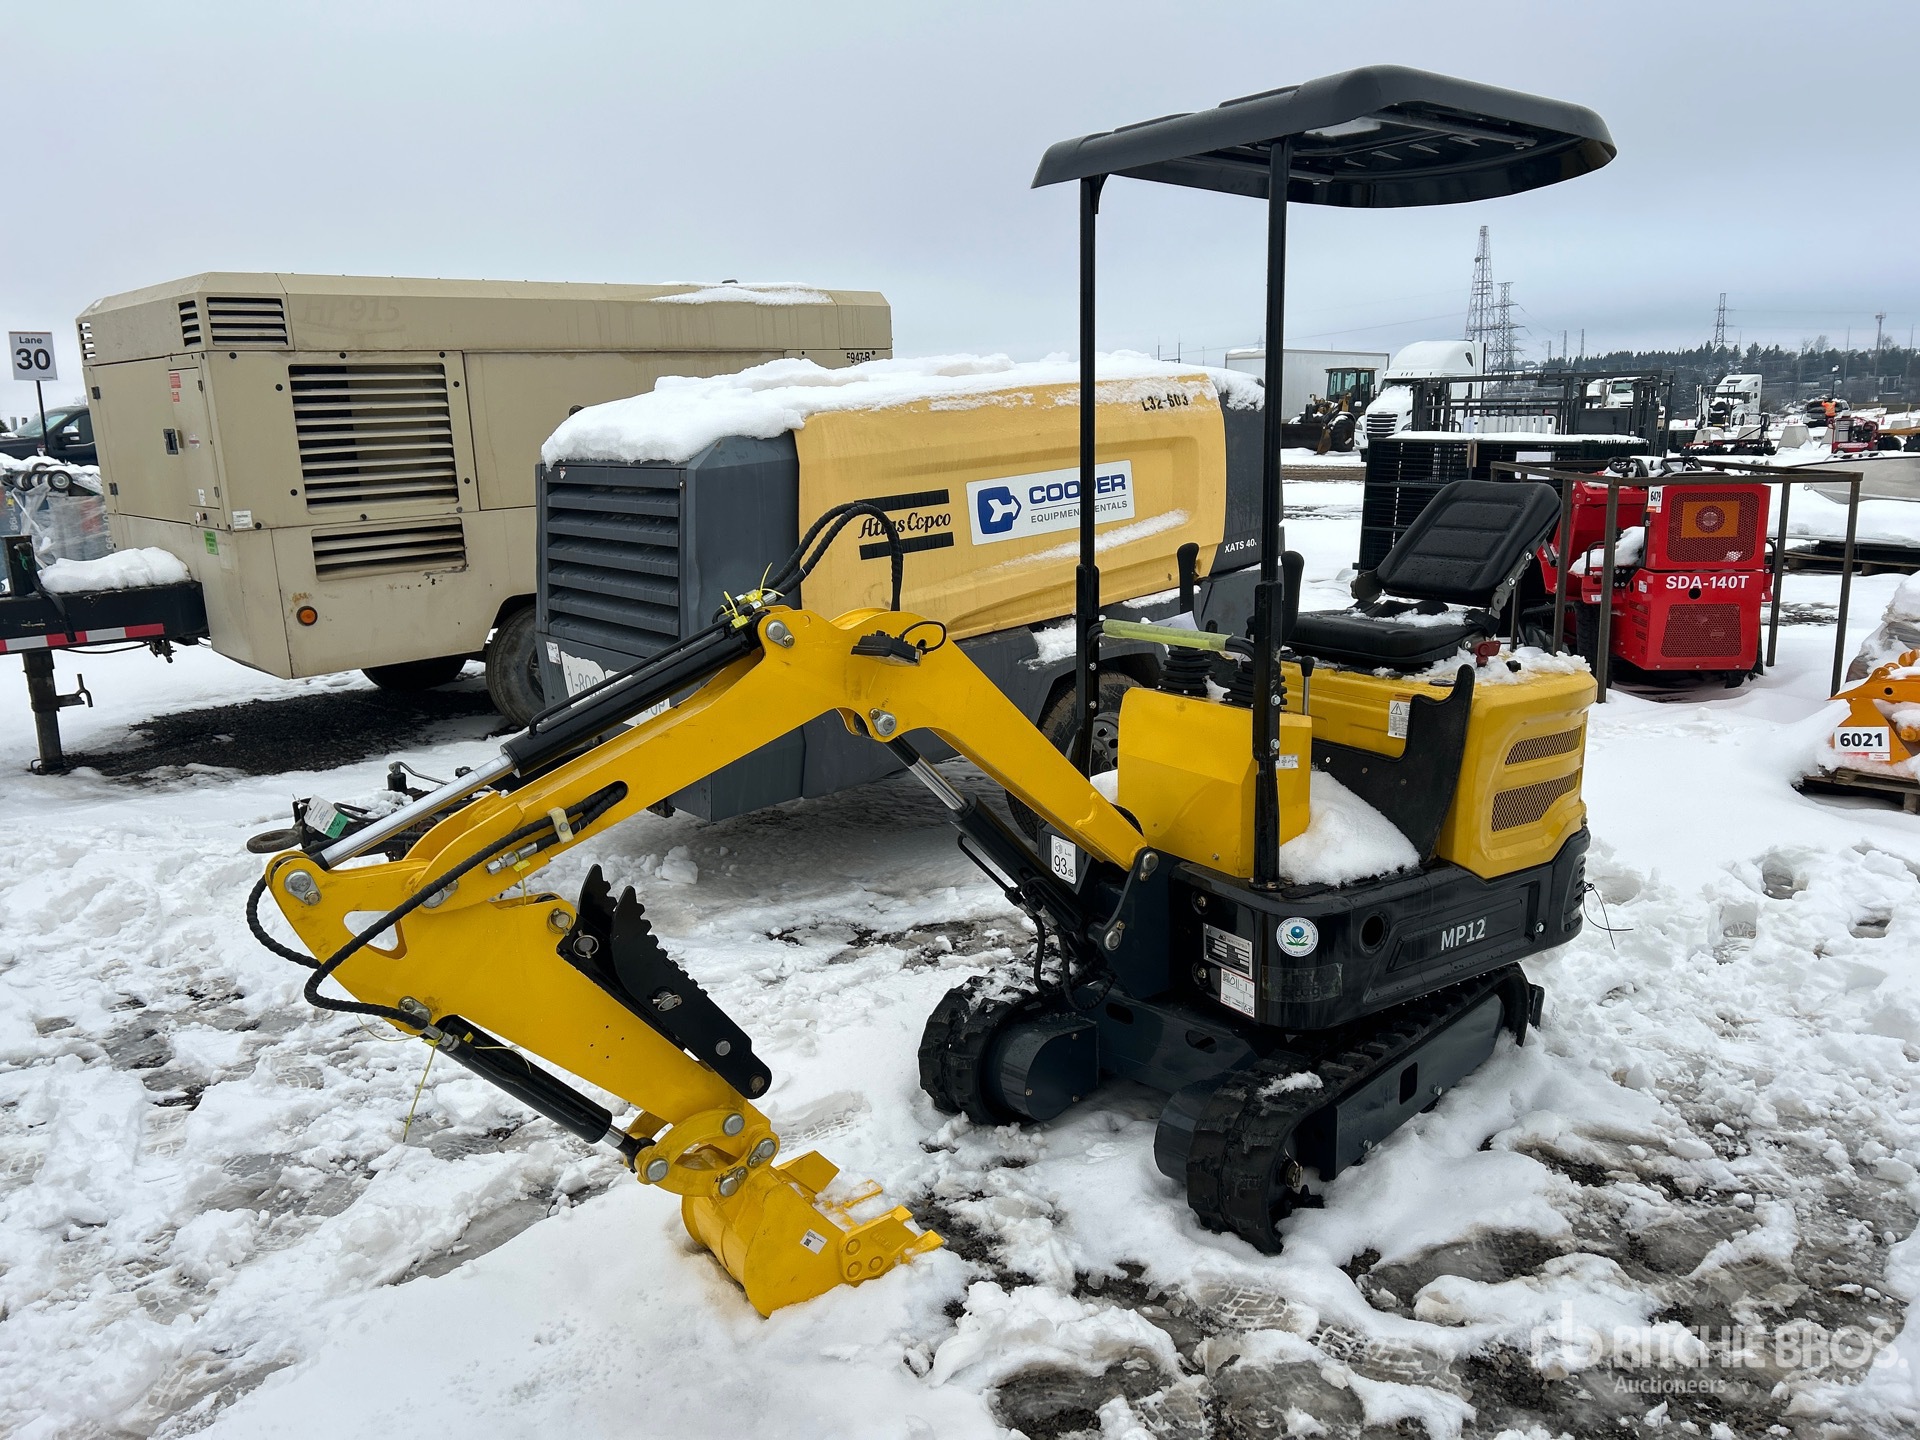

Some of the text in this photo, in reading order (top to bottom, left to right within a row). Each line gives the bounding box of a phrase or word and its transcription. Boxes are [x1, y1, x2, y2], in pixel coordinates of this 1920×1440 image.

[19, 336, 43, 344] Lane
[15, 348, 51, 371] 30
[1028, 473, 1126, 505] COOER
[907, 511, 951, 533] Copco
[1030, 500, 1128, 524] EQUIPMEN ENTALS
[1224, 540, 1245, 554] XATS
[1665, 575, 1750, 590] SDA-140T
[1839, 732, 1884, 747] 6021
[1054, 854, 1068, 876] 93
[1440, 917, 1487, 951] MP12
